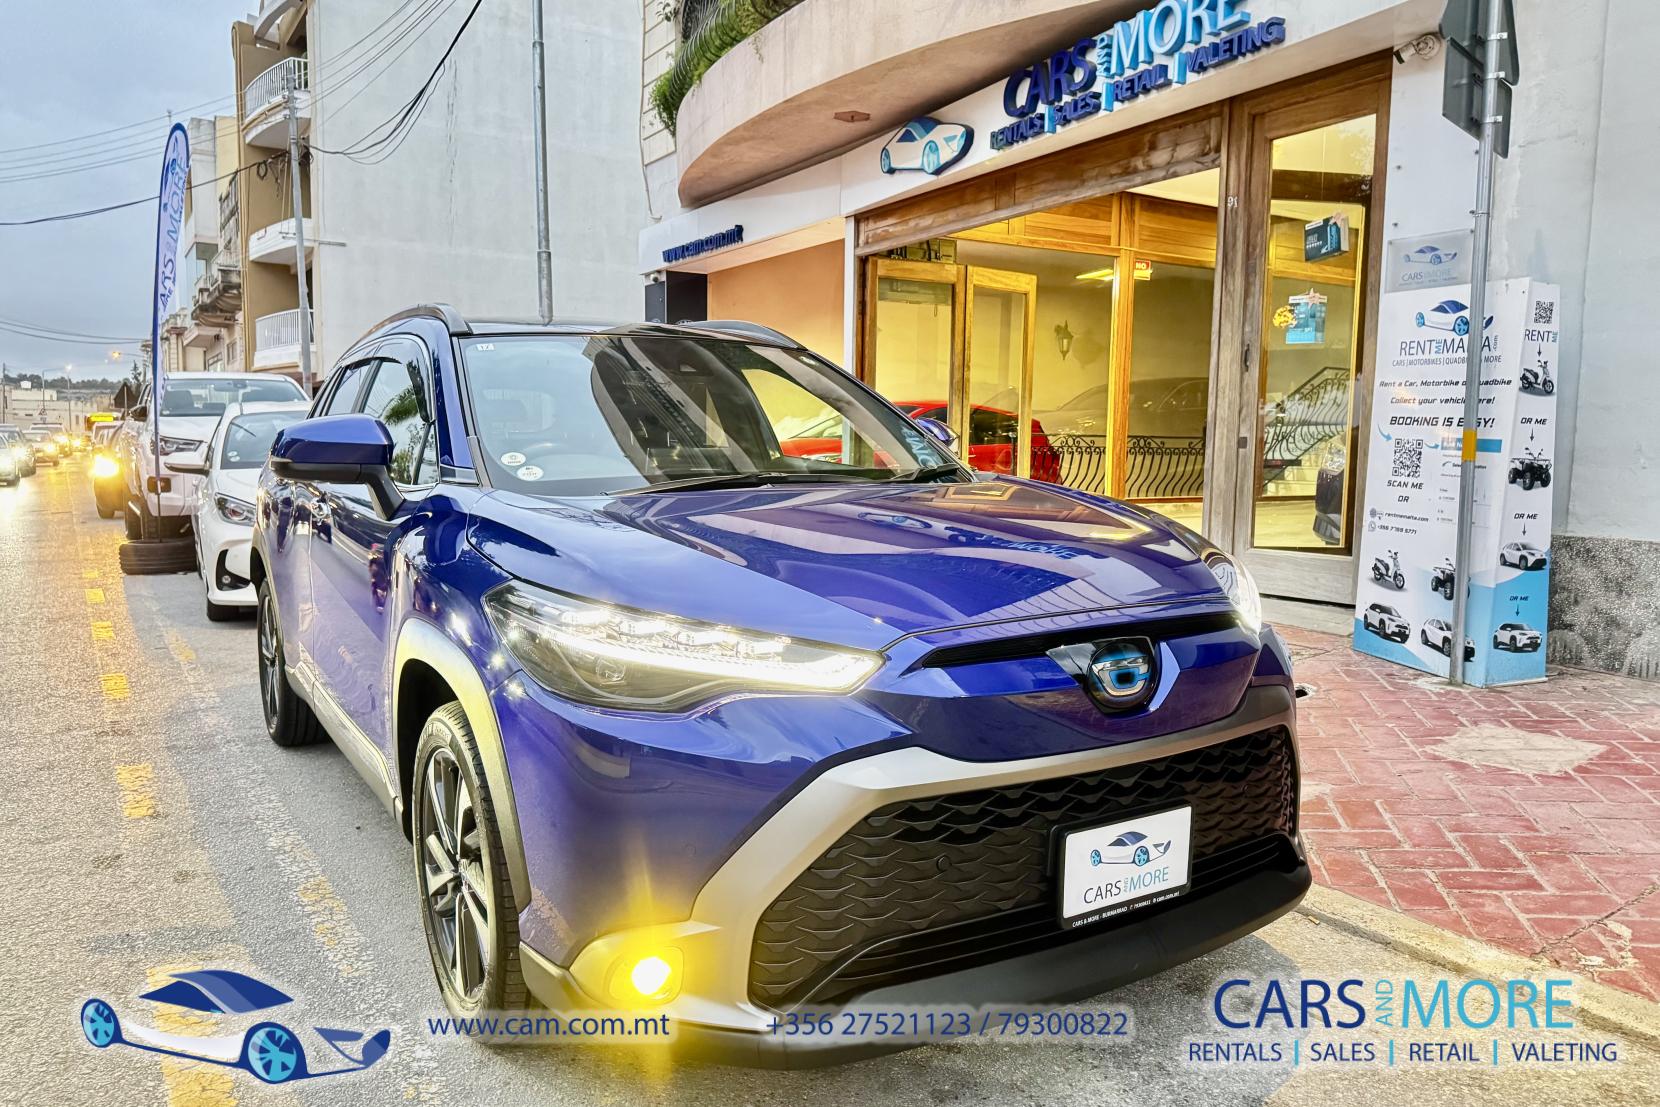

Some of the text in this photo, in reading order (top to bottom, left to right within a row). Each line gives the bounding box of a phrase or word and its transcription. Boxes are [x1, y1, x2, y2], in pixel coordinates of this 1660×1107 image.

[1003, 38, 1098, 118] CARS
[1110, 0, 1251, 76] MORE
[990, 17, 1286, 150] RENTALS SALES RETAIL VALETING
[662, 224, 744, 263] www.cam.com.mt
[1402, 272, 1423, 281] CARS
[1524, 328, 1552, 343] RENT
[1400, 339, 1435, 356] RENT
[1442, 336, 1491, 354] MAA
[1392, 359, 1405, 367] CARS
[1408, 358, 1441, 367] MOTORBIKES
[1484, 355, 1502, 363] MORE
[1379, 380, 1396, 388] Rent
[1404, 379, 1418, 388] Car,
[1420, 379, 1460, 387] Motorbike
[1479, 378, 1512, 386] uadbike
[1418, 397, 1438, 406] your
[1439, 396, 1466, 405] vehicl
[1478, 396, 1496, 404] ere!
[1389, 416, 1496, 428] BOOKING IS ESY!
[1520, 417, 1548, 426] OR ME
[1387, 480, 1424, 490] SCAN ME
[1397, 495, 1410, 503] OR
[1513, 512, 1525, 520] OR
[1084, 880, 1122, 904] CARS
[1129, 866, 1169, 892] MORE
